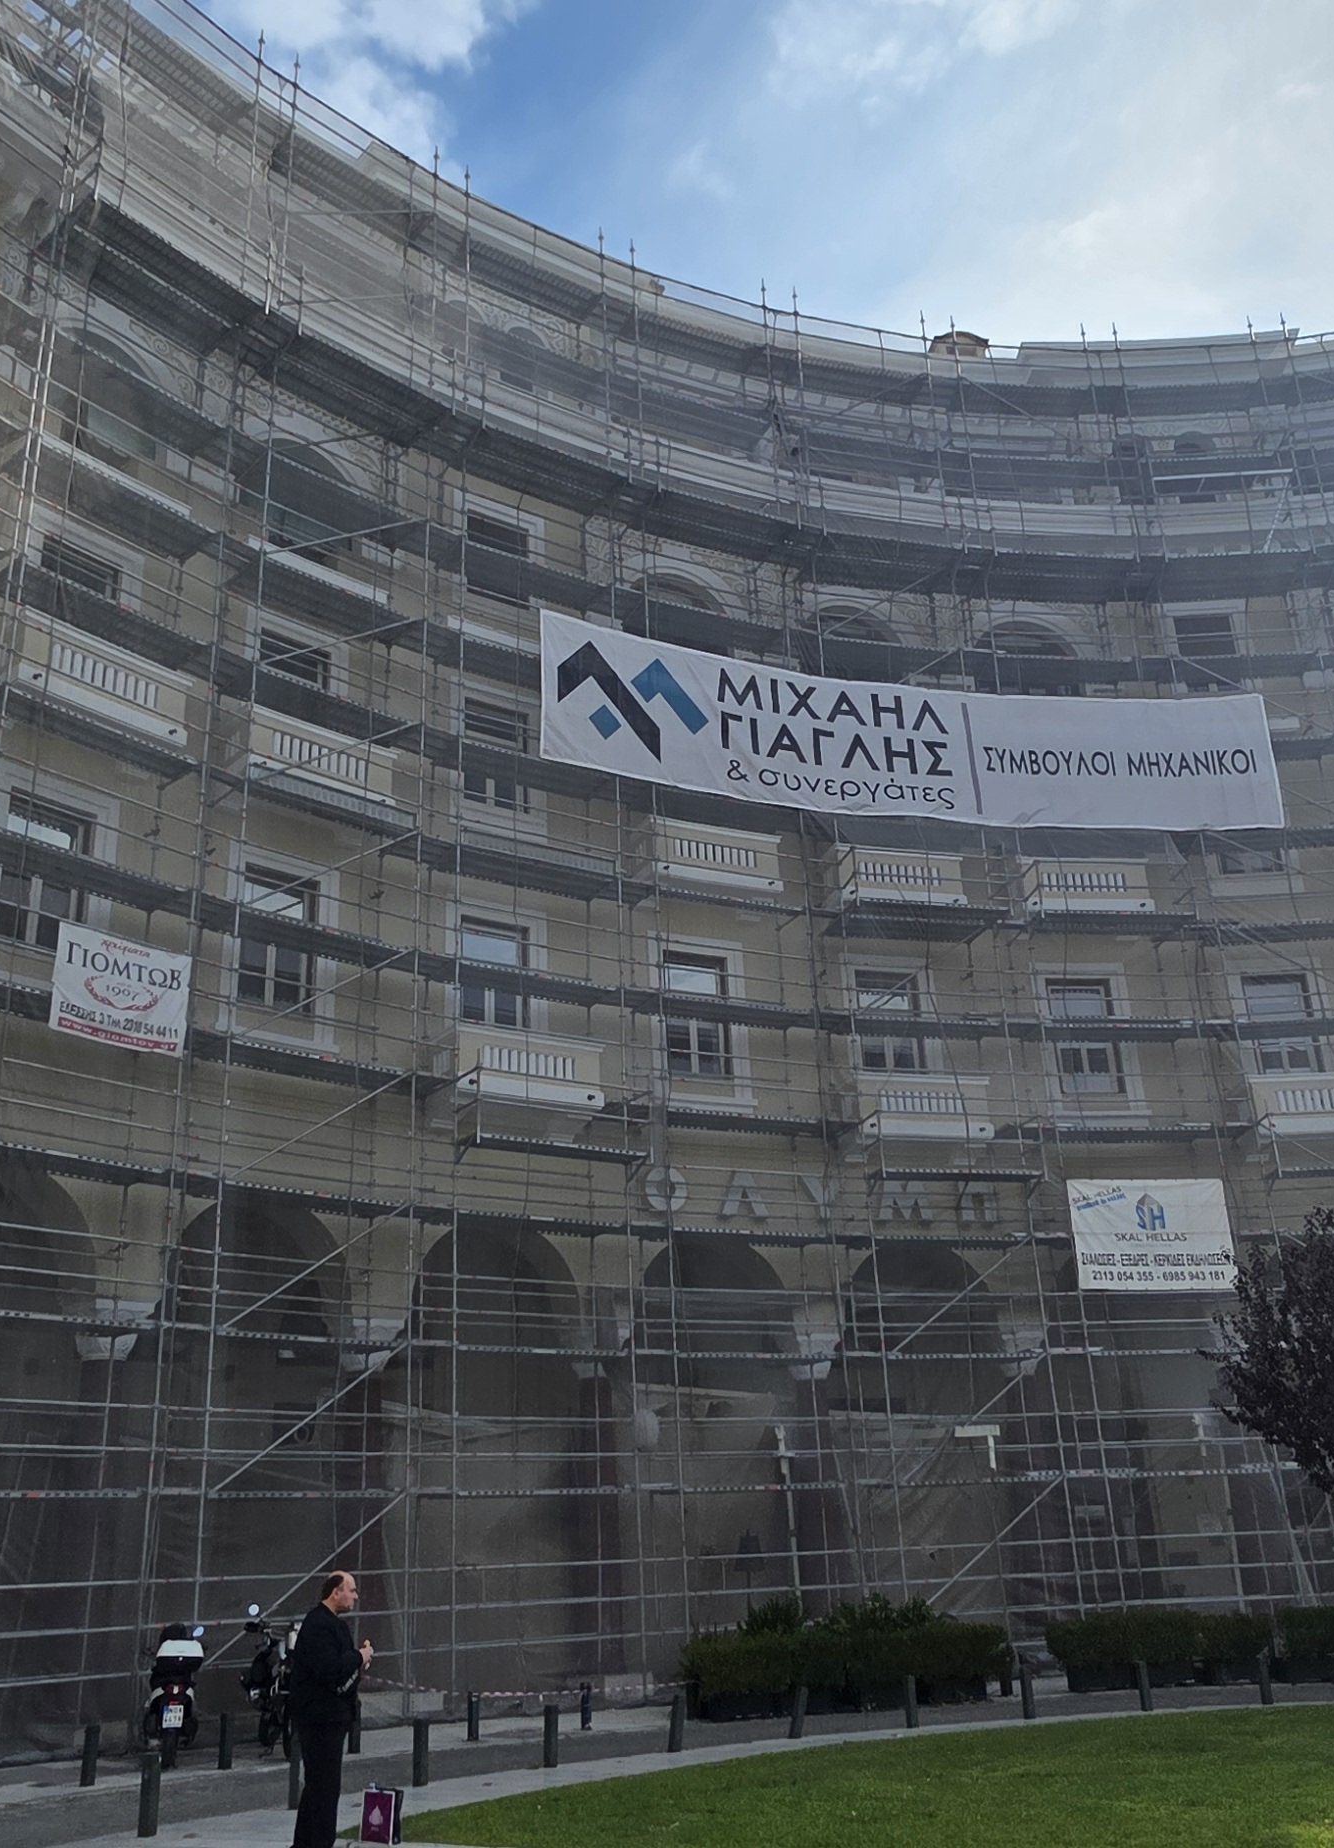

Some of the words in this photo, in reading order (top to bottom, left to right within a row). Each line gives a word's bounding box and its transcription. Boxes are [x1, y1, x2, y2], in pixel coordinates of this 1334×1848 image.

[715, 667, 950, 735] ΜΙΧΑΗΛ
[719, 710, 953, 777] ΓΙΑΓΛΗΣ
[984, 744, 1117, 777] ΣΥΜΒΟΥΛΟΙ
[1126, 750, 1258, 775] ΜΗΧΑΝΙΚΟΙ
[727, 759, 750, 783] &
[757, 769, 956, 811] συνεργάτες
[66, 940, 182, 991] ΓΙΟΜΤΩΒ
[106, 984, 140, 1001] 1907
[99, 1012, 105, 1025] 3
[143, 1023, 154, 1036] 54
[156, 1026, 167, 1038] 44
[169, 1027, 178, 1039] 11
[1114, 1233, 1143, 1242] SKAL
[1146, 1233, 1187, 1242] HELLAS
[1092, 1270, 1115, 1281] 2313
[1117, 1270, 1134, 1281] 054
[1137, 1270, 1154, 1281] 355
[1162, 1270, 1186, 1281] 6985
[1188, 1270, 1206, 1281] 943
[1209, 1270, 1225, 1281] 181
